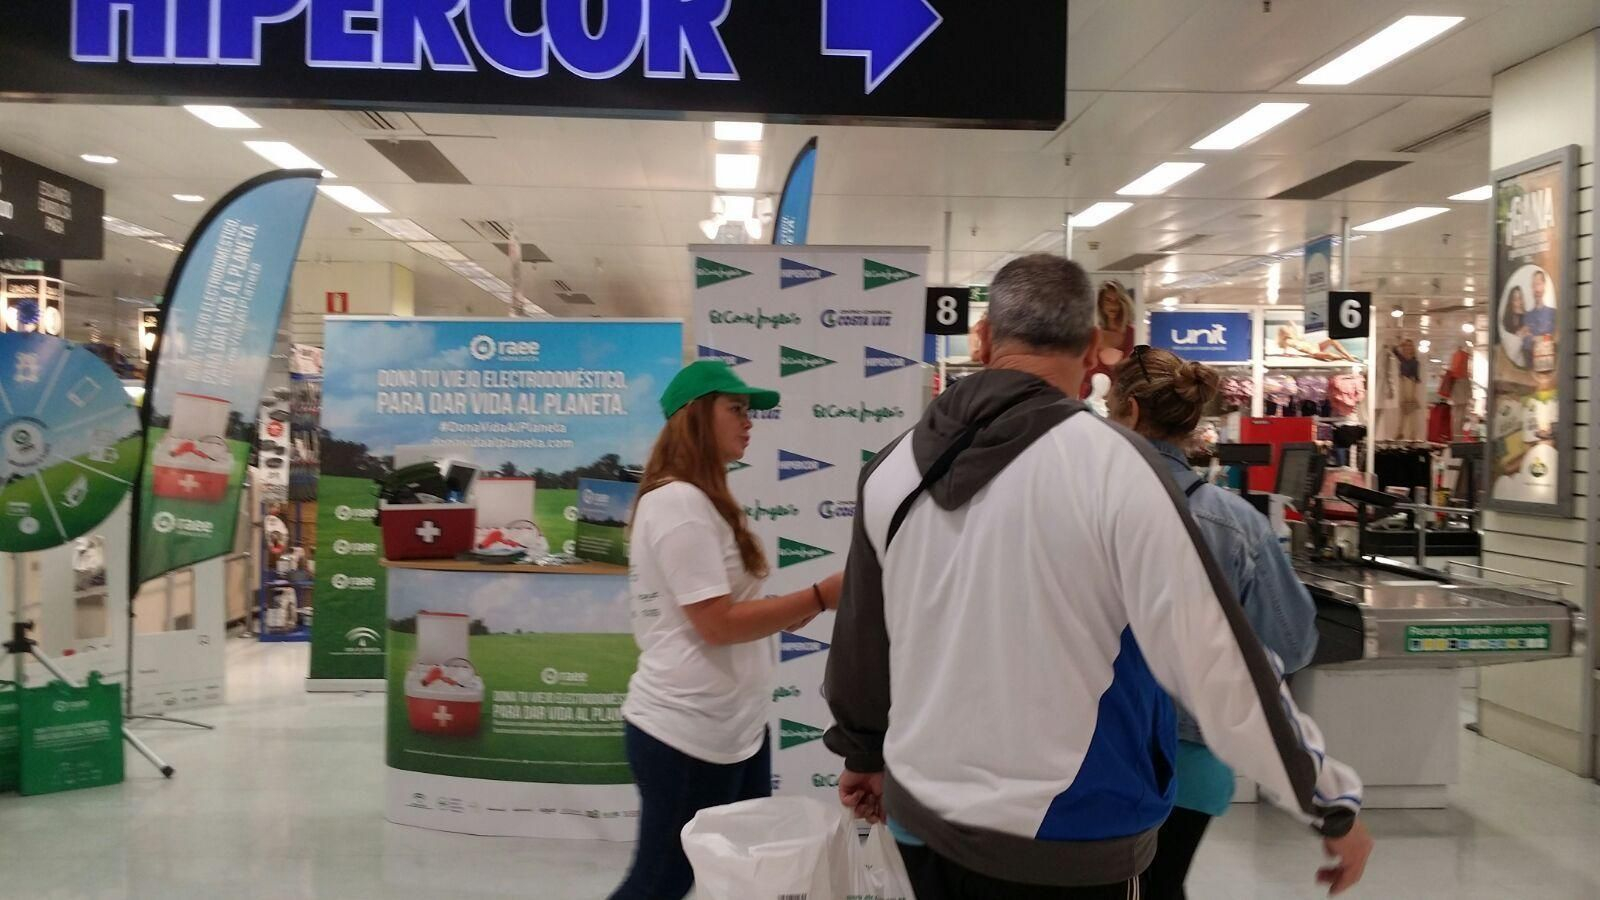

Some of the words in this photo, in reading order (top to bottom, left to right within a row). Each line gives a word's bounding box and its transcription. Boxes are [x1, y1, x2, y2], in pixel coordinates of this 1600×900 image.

[936, 295, 958, 326] 8
[1339, 299, 1362, 329] 6
[1170, 323, 1227, 345] unit
[498, 341, 540, 356] raee
[377, 369, 417, 388] DONA
[420, 369, 440, 388] TU
[441, 369, 480, 388] VIEJO
[377, 391, 425, 415] PARA
[429, 391, 467, 415] DAR
[470, 391, 513, 415] VIDA
[517, 392, 540, 415] AL
